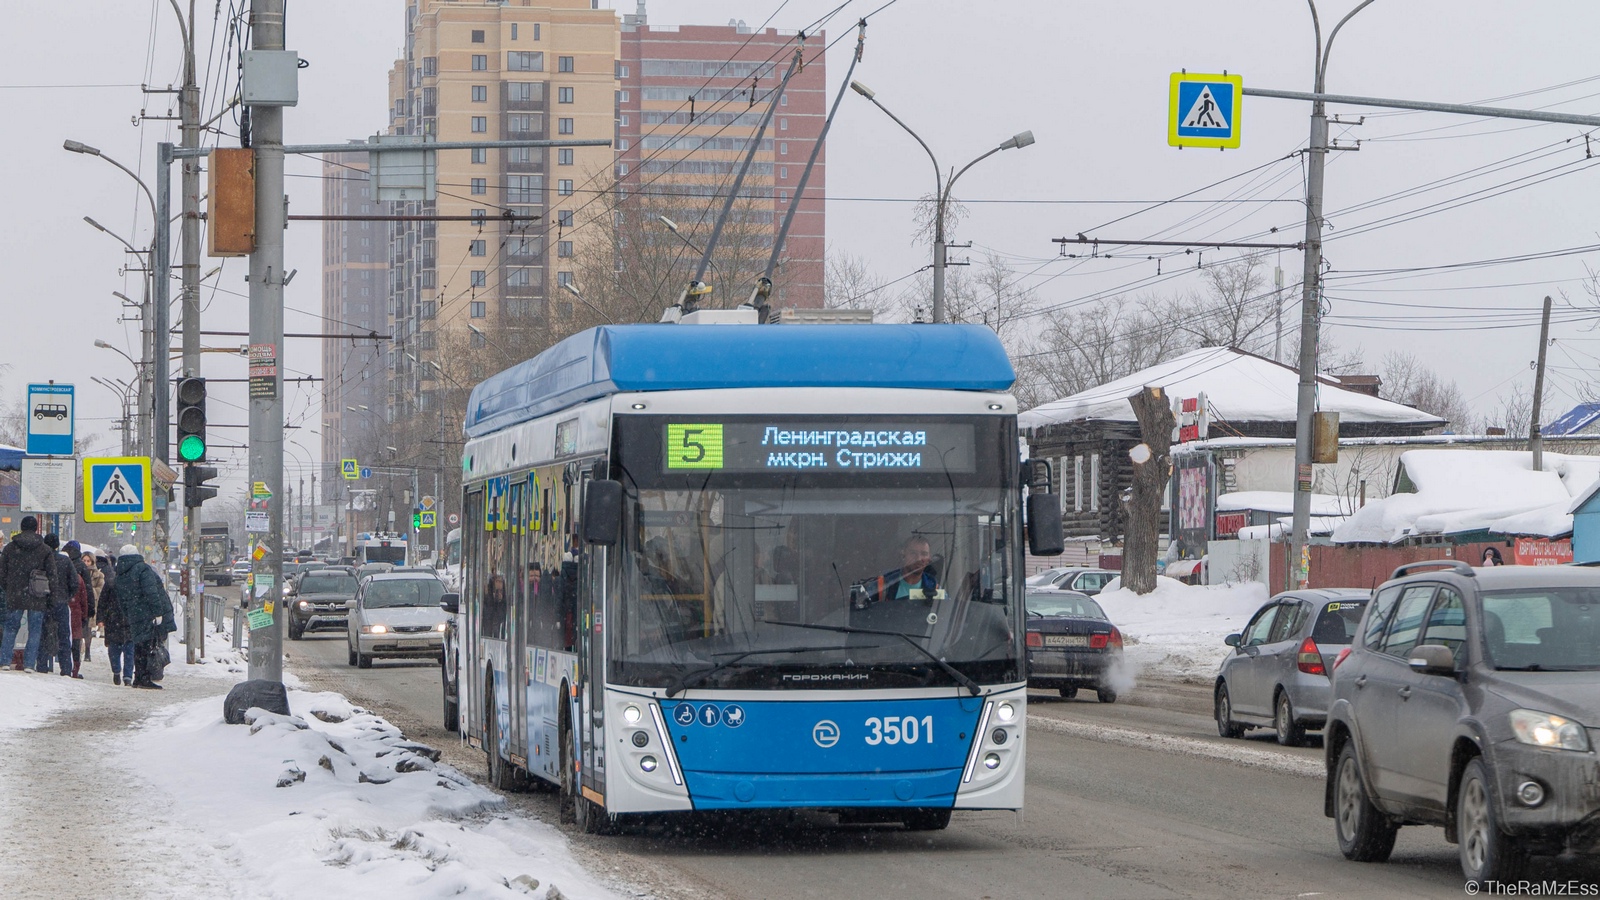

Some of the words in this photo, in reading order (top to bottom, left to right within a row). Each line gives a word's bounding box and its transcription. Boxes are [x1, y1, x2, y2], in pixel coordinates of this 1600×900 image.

[682, 429, 705, 462] 5
[762, 426, 926, 447] Ленинградская
[767, 452, 828, 468] мкрн.
[836, 449, 921, 468] Стрижи
[864, 715, 933, 746] 3501
